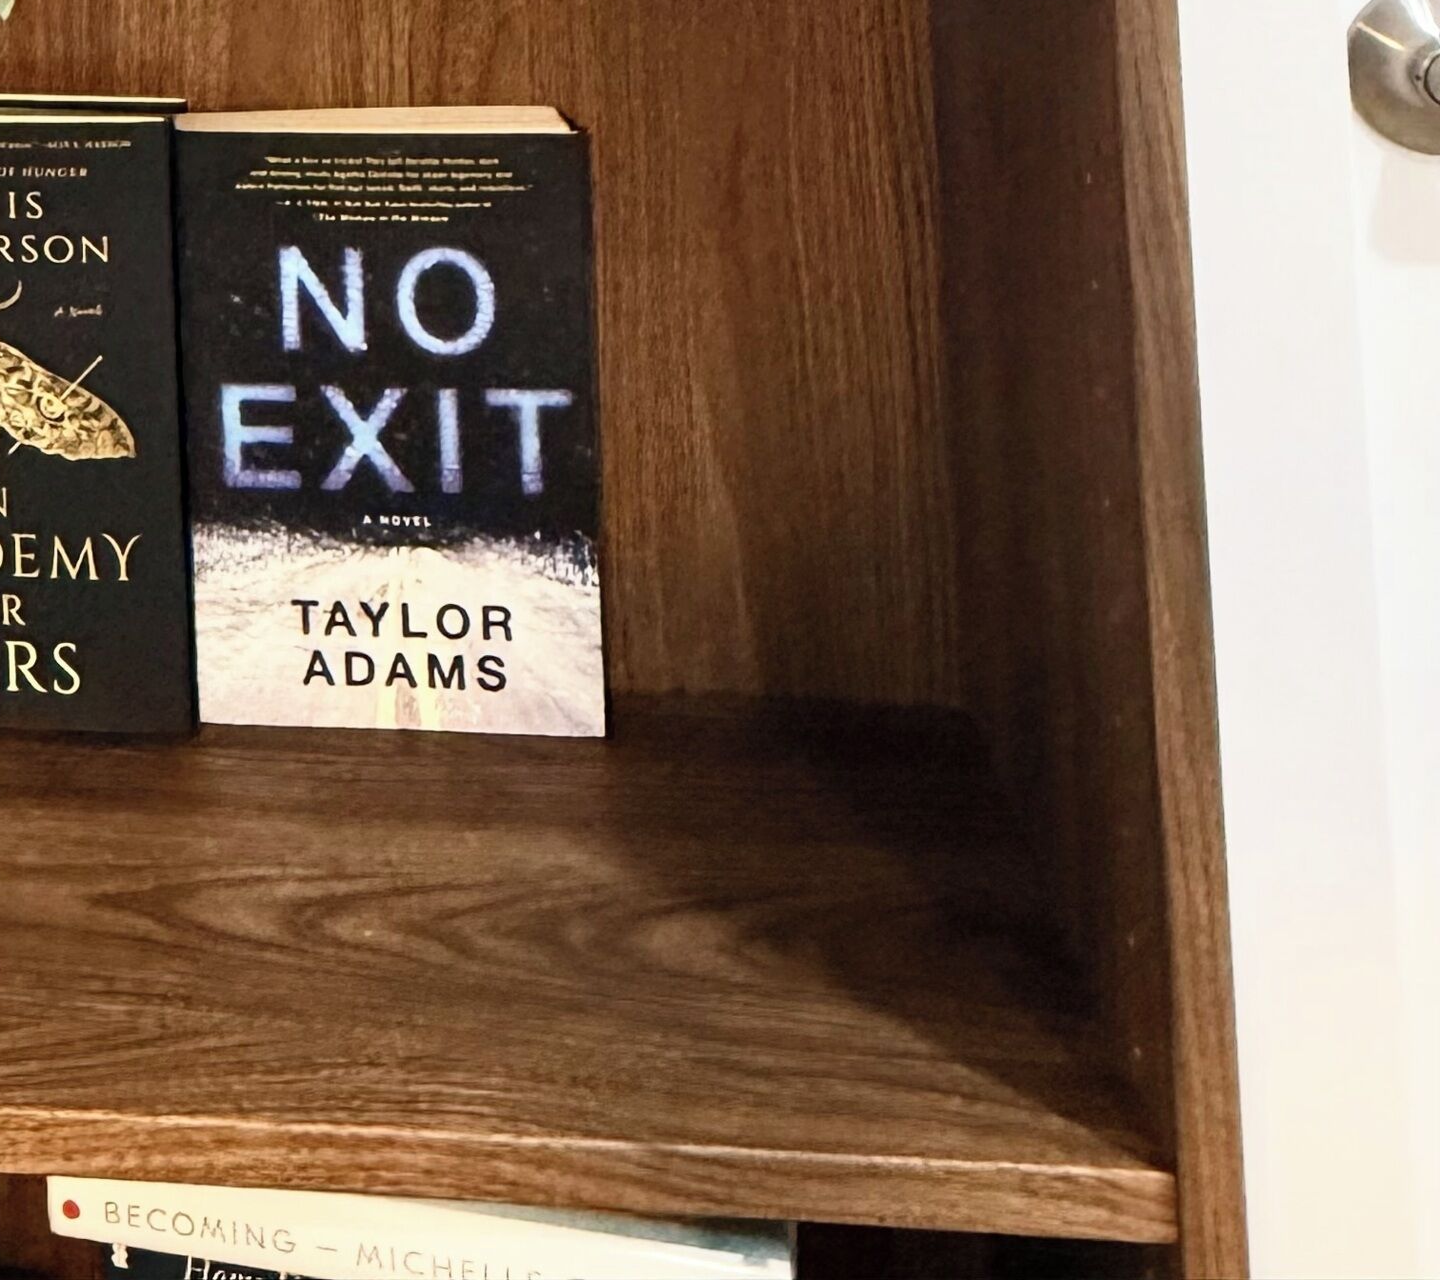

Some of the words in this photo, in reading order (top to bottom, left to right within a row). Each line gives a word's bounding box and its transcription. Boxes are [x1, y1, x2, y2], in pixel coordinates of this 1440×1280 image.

[278, 244, 497, 357] NO
[218, 382, 574, 495] EXIT
[362, 514, 372, 525] A
[378, 514, 433, 528] NOVEL
[291, 599, 514, 641] TAYLOR
[303, 650, 509, 692] ADAMS
[104, 1200, 298, 1254] BECOMING
